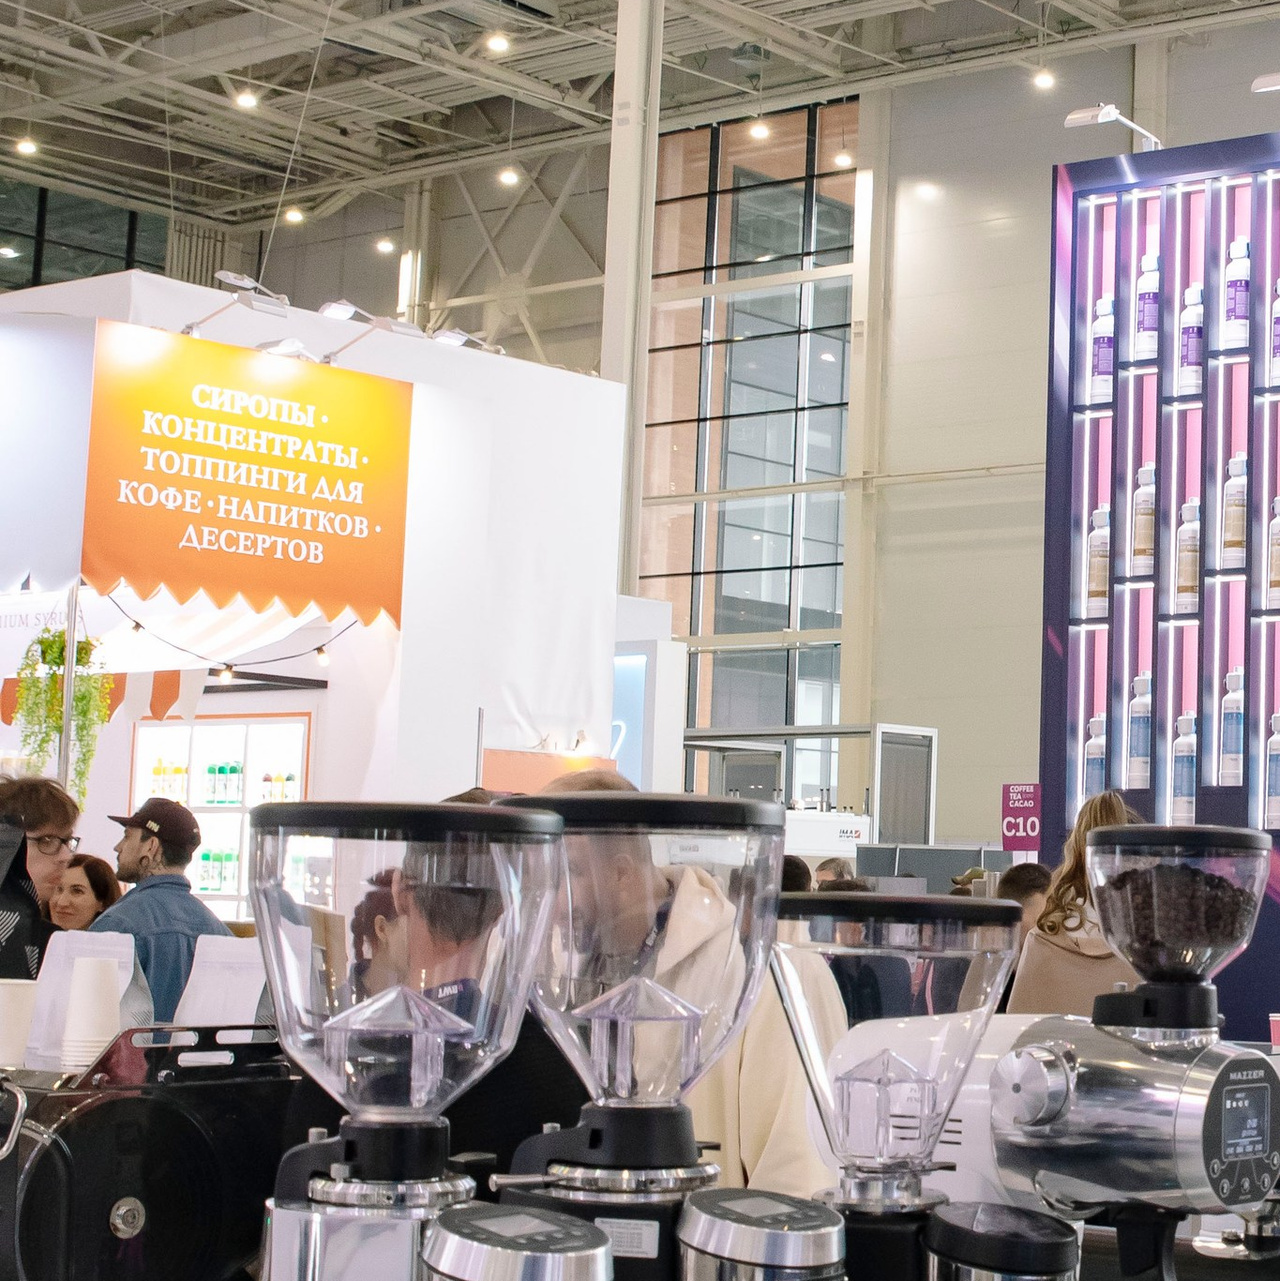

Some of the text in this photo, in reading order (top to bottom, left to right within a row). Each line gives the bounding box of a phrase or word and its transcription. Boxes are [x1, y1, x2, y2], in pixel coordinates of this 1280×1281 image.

[192, 384, 316, 427] СИРОПЫ
[142, 410, 359, 469] КОНЦЕНТРАТЫ
[140, 446, 364, 504] ТОППИНГИ ДЛЯ
[117, 479, 369, 538] КОФЕ НАПИТКОВ
[179, 524, 324, 564] ДЕСЕРТОВ
[1009, 800, 1034, 808] CACAO
[1003, 817, 1039, 837] C10
[1230, 1070, 1265, 1080] MAZZER
